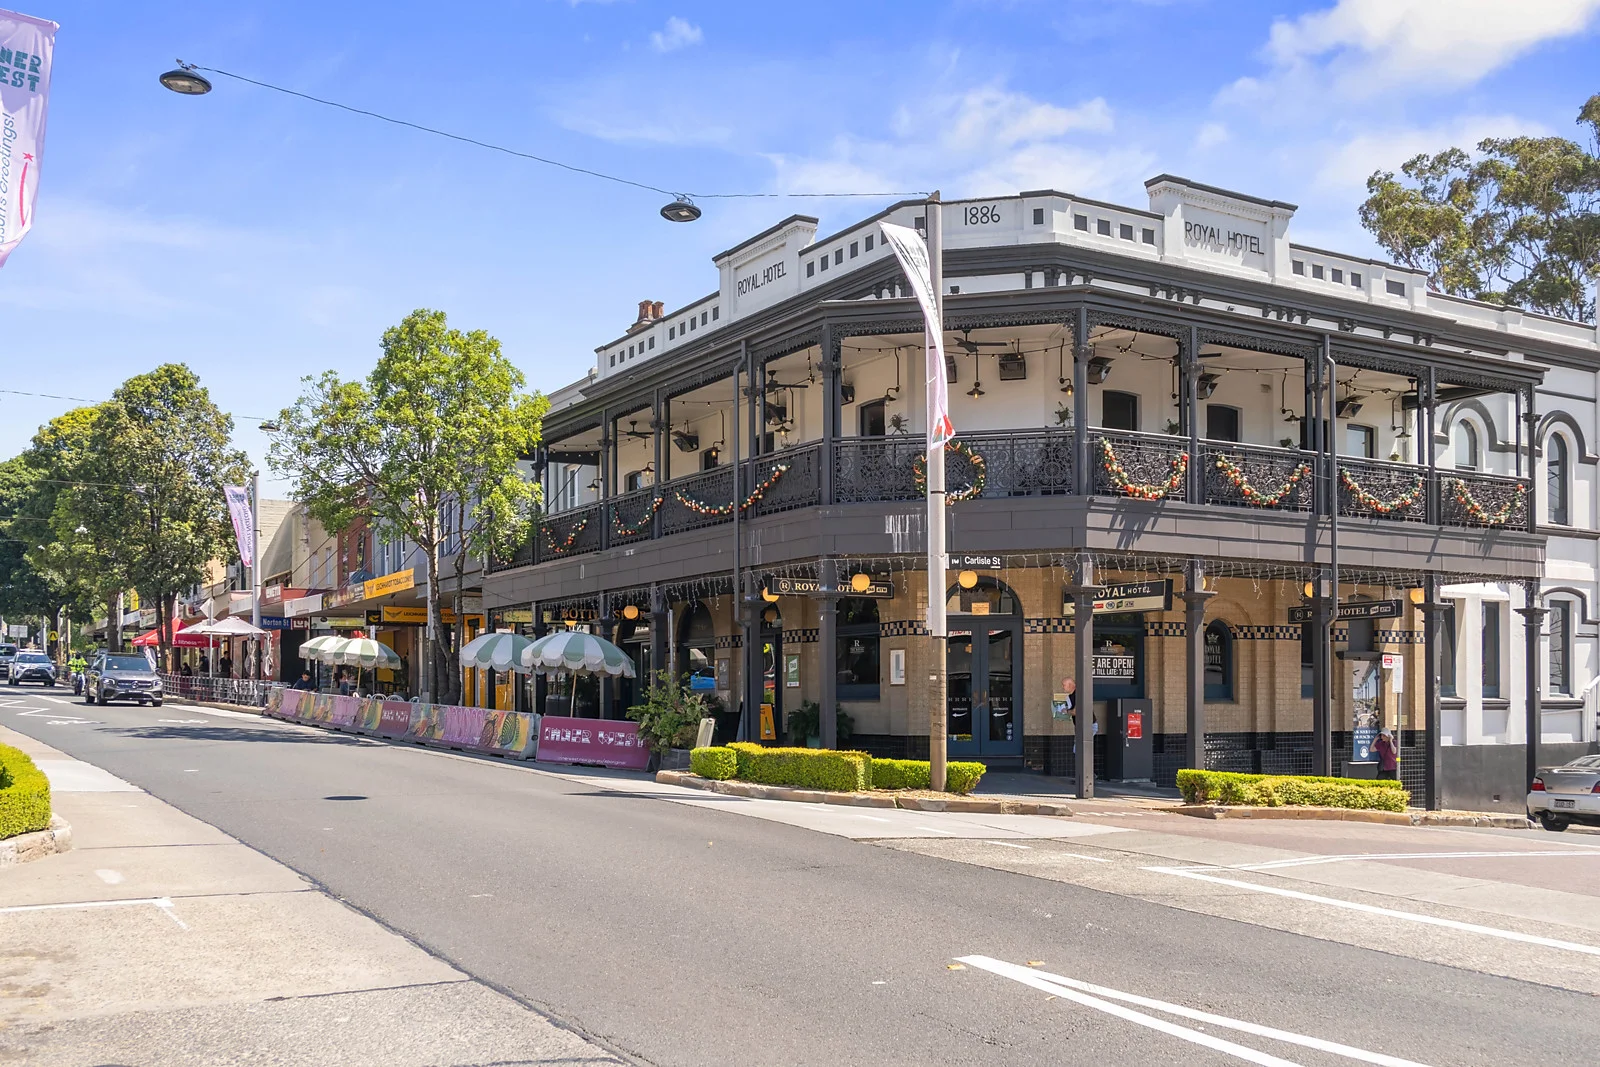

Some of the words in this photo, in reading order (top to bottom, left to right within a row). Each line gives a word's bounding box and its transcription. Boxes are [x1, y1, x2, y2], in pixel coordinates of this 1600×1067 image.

[964, 204, 1001, 226] 1886
[1184, 221, 1224, 246] ROYAL
[1227, 230, 1265, 255] HOTEL
[964, 556, 991, 565] Carlisle
[992, 556, 1001, 565] St
[794, 582, 820, 592] ROYA
[1093, 586, 1126, 599] OYAL
[1127, 586, 1151, 594] HOTEL
[1338, 607, 1368, 616] HOTEL
[262, 618, 282, 626] Norton
[282, 619, 290, 627] St
[1096, 658, 1111, 669] ARE
[1112, 658, 1134, 669] OPEN!
[544, 727, 592, 744] INNER
